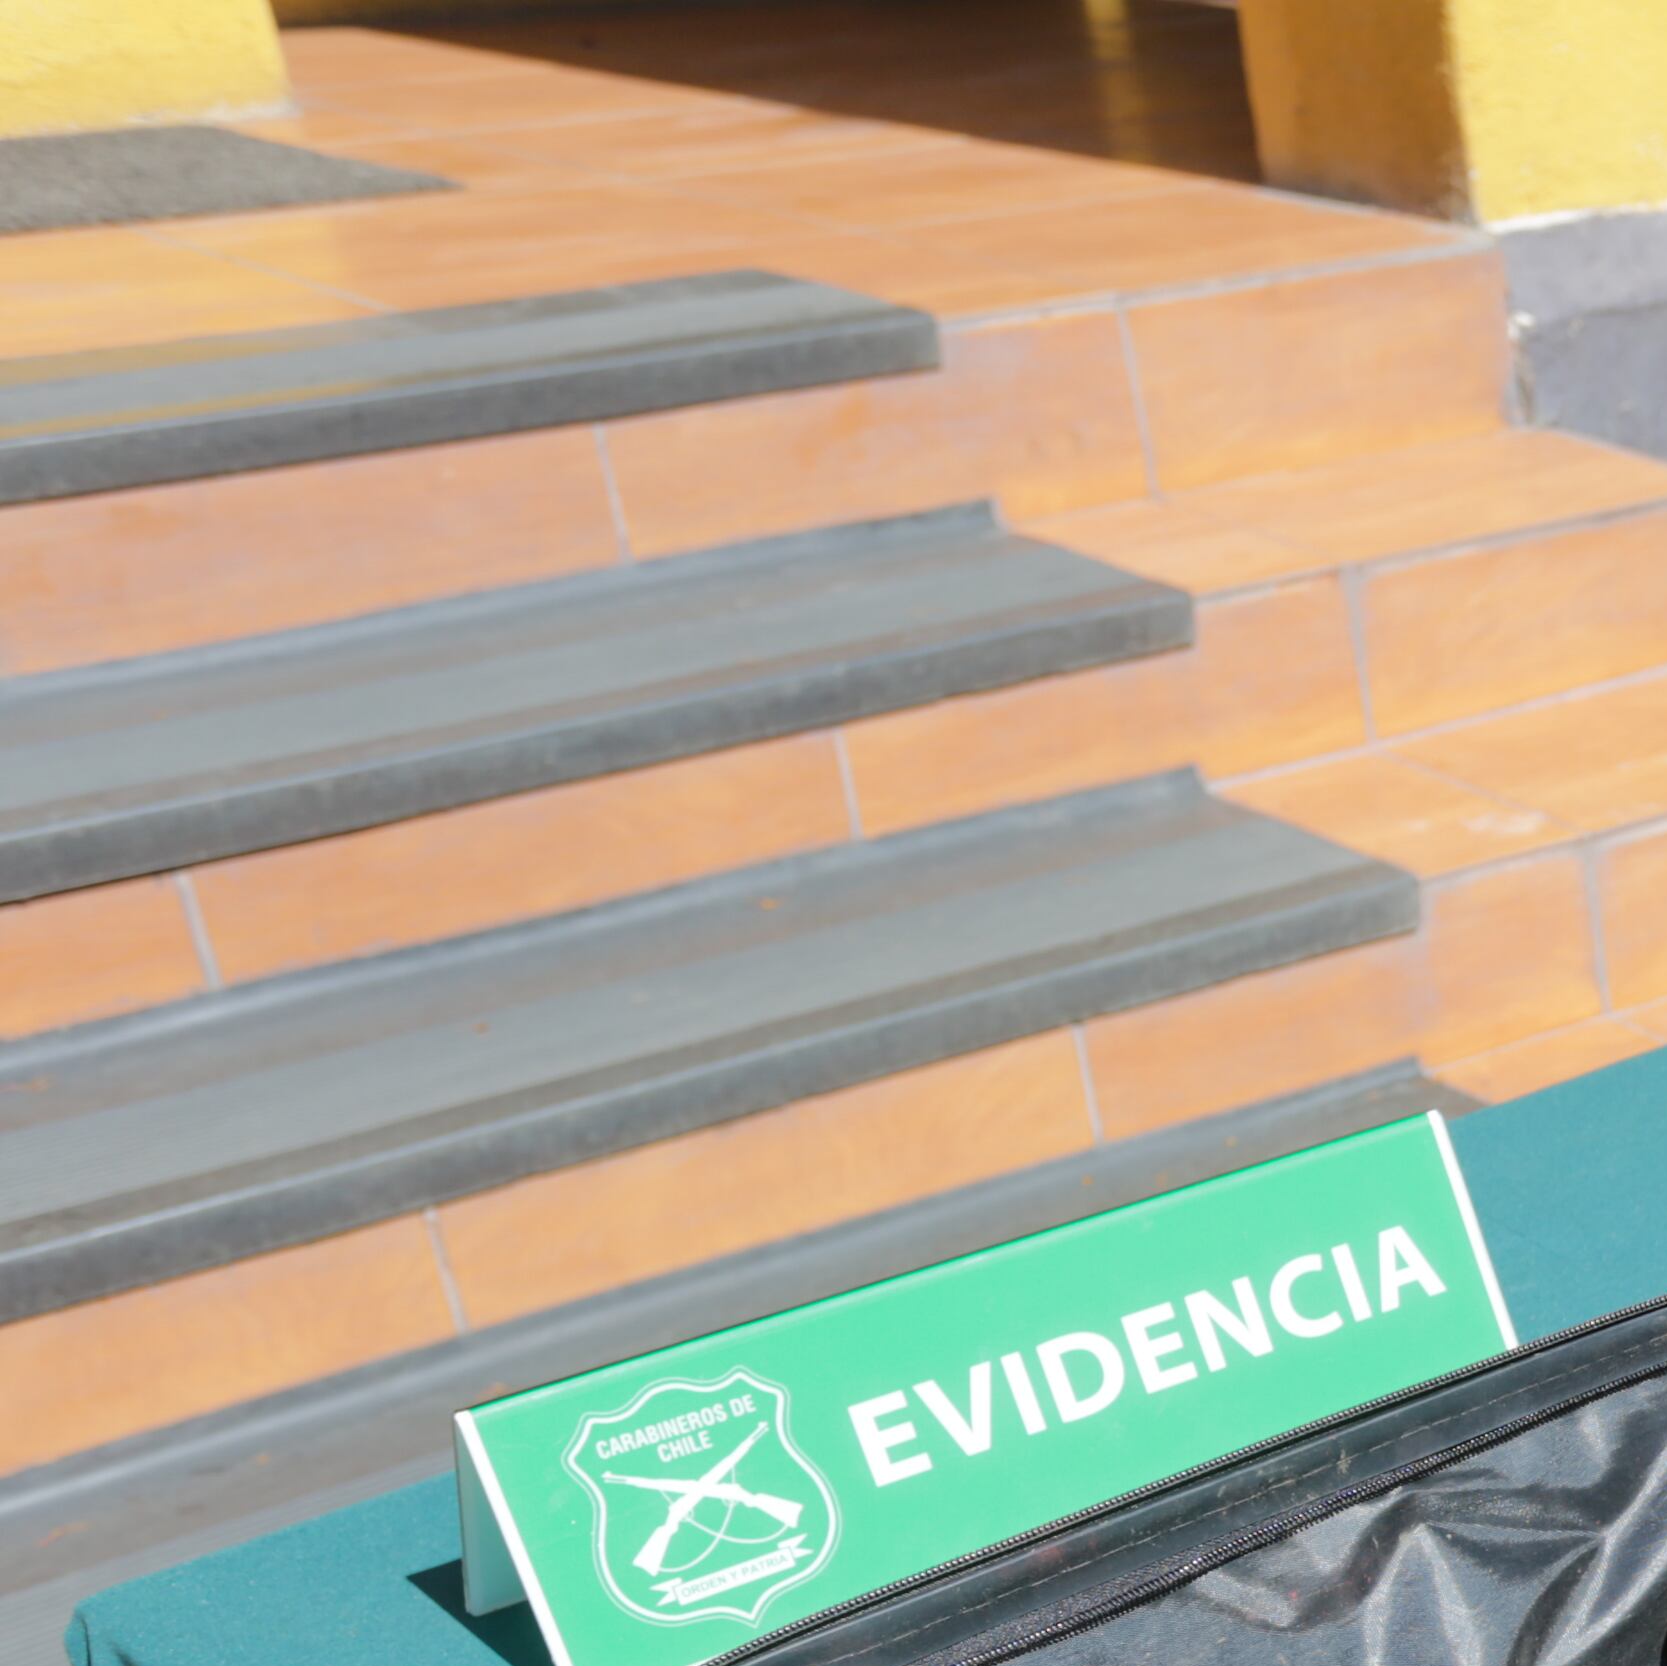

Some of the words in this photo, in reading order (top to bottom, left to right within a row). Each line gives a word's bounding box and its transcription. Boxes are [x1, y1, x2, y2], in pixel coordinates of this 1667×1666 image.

[847, 1225, 1448, 1488] EVIDENCIA
[596, 1404, 728, 1460] CARABINEROS
[730, 1395, 756, 1419] DE
[657, 1430, 713, 1463] CHILE
[681, 1575, 727, 1598] ORDEN
[743, 1554, 788, 1576] PATRIA
